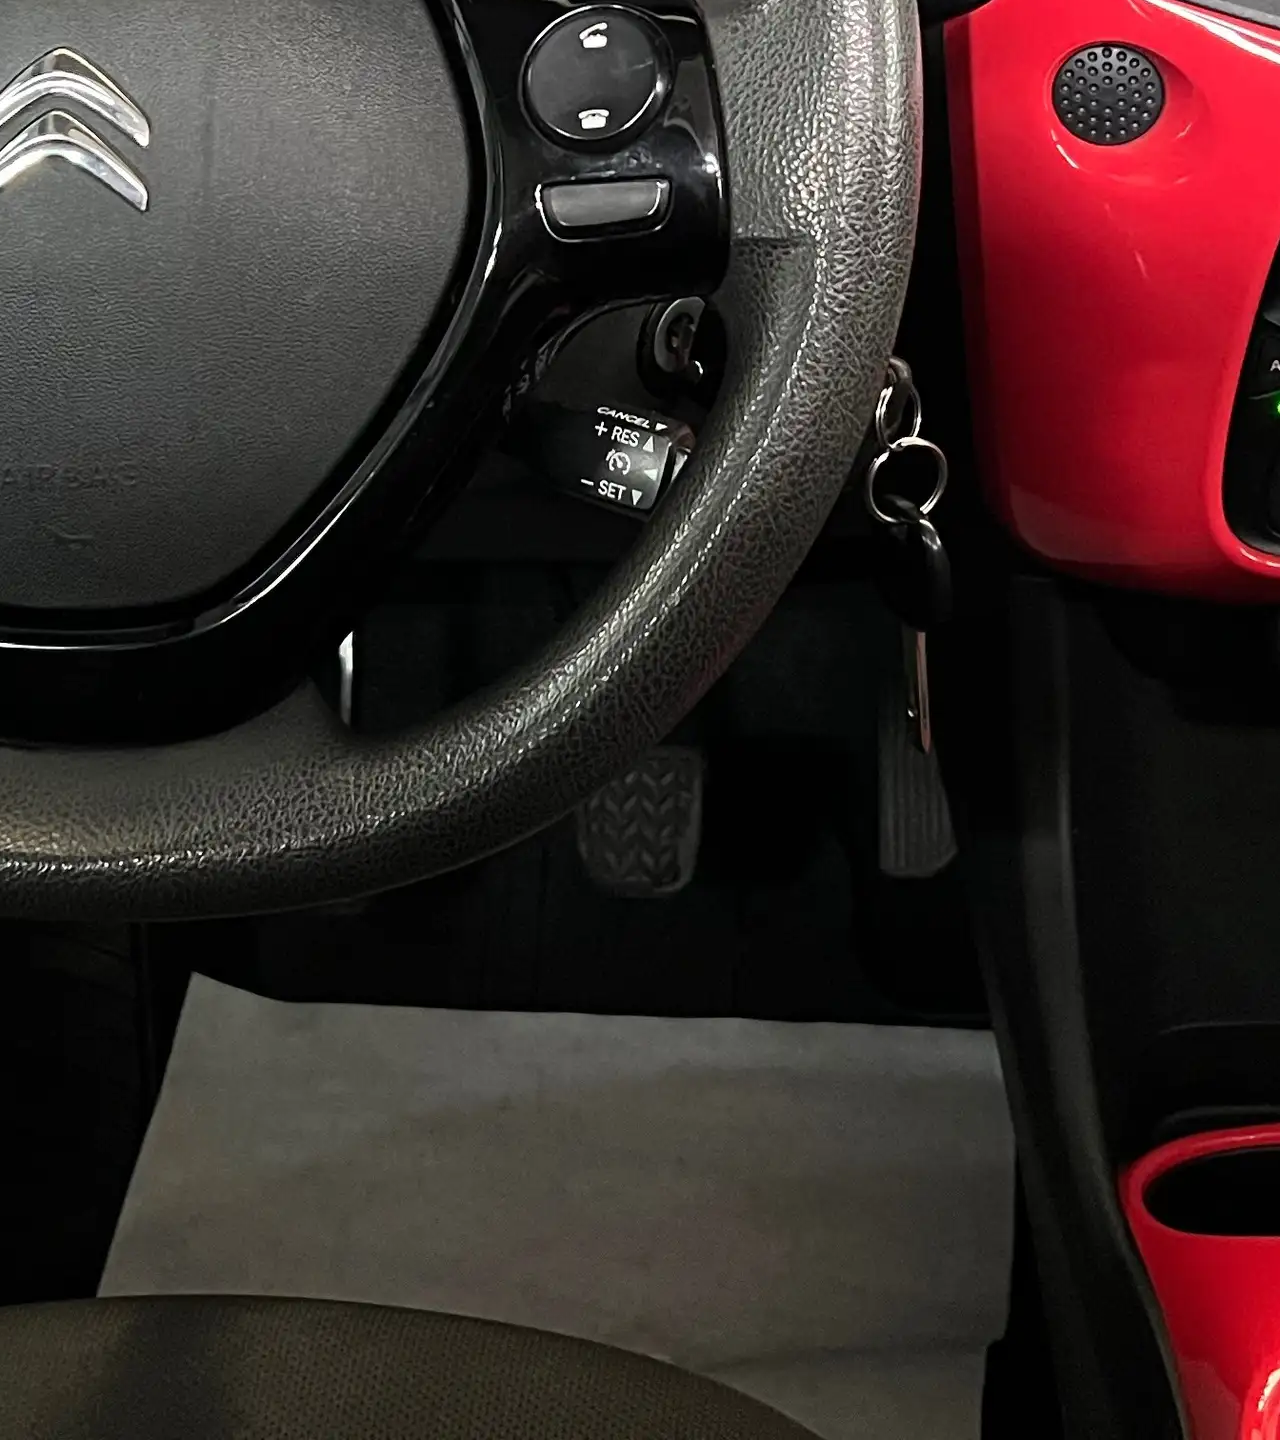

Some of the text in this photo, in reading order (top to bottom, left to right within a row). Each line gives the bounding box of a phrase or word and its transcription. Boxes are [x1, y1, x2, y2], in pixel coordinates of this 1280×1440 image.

[597, 406, 651, 429] CANCEL
[611, 425, 641, 448] RES
[597, 479, 627, 501] SET
